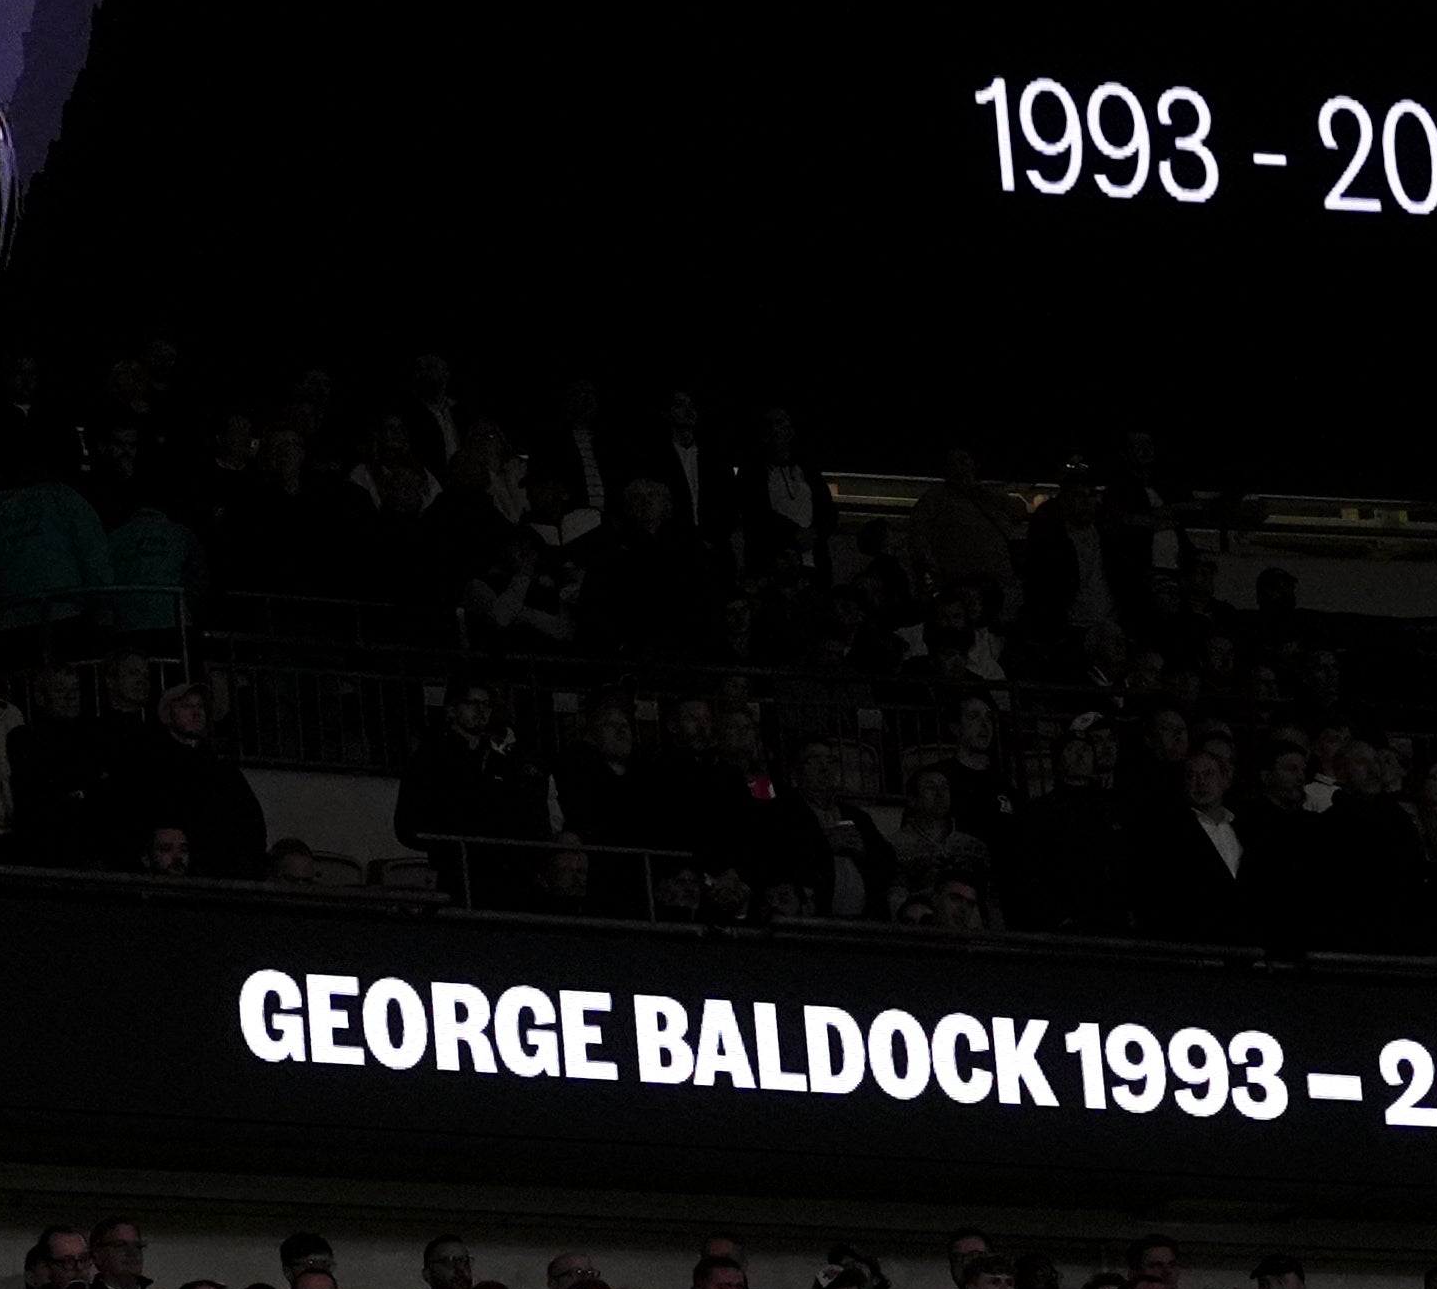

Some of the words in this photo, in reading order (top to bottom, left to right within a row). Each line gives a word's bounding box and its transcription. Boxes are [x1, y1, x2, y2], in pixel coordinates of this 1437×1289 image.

[974, 77, 1220, 203] 1993
[239, 968, 618, 1081] GEORGE
[634, 995, 1059, 1107] BALDOCK
[1065, 1022, 1288, 1121] 1993
